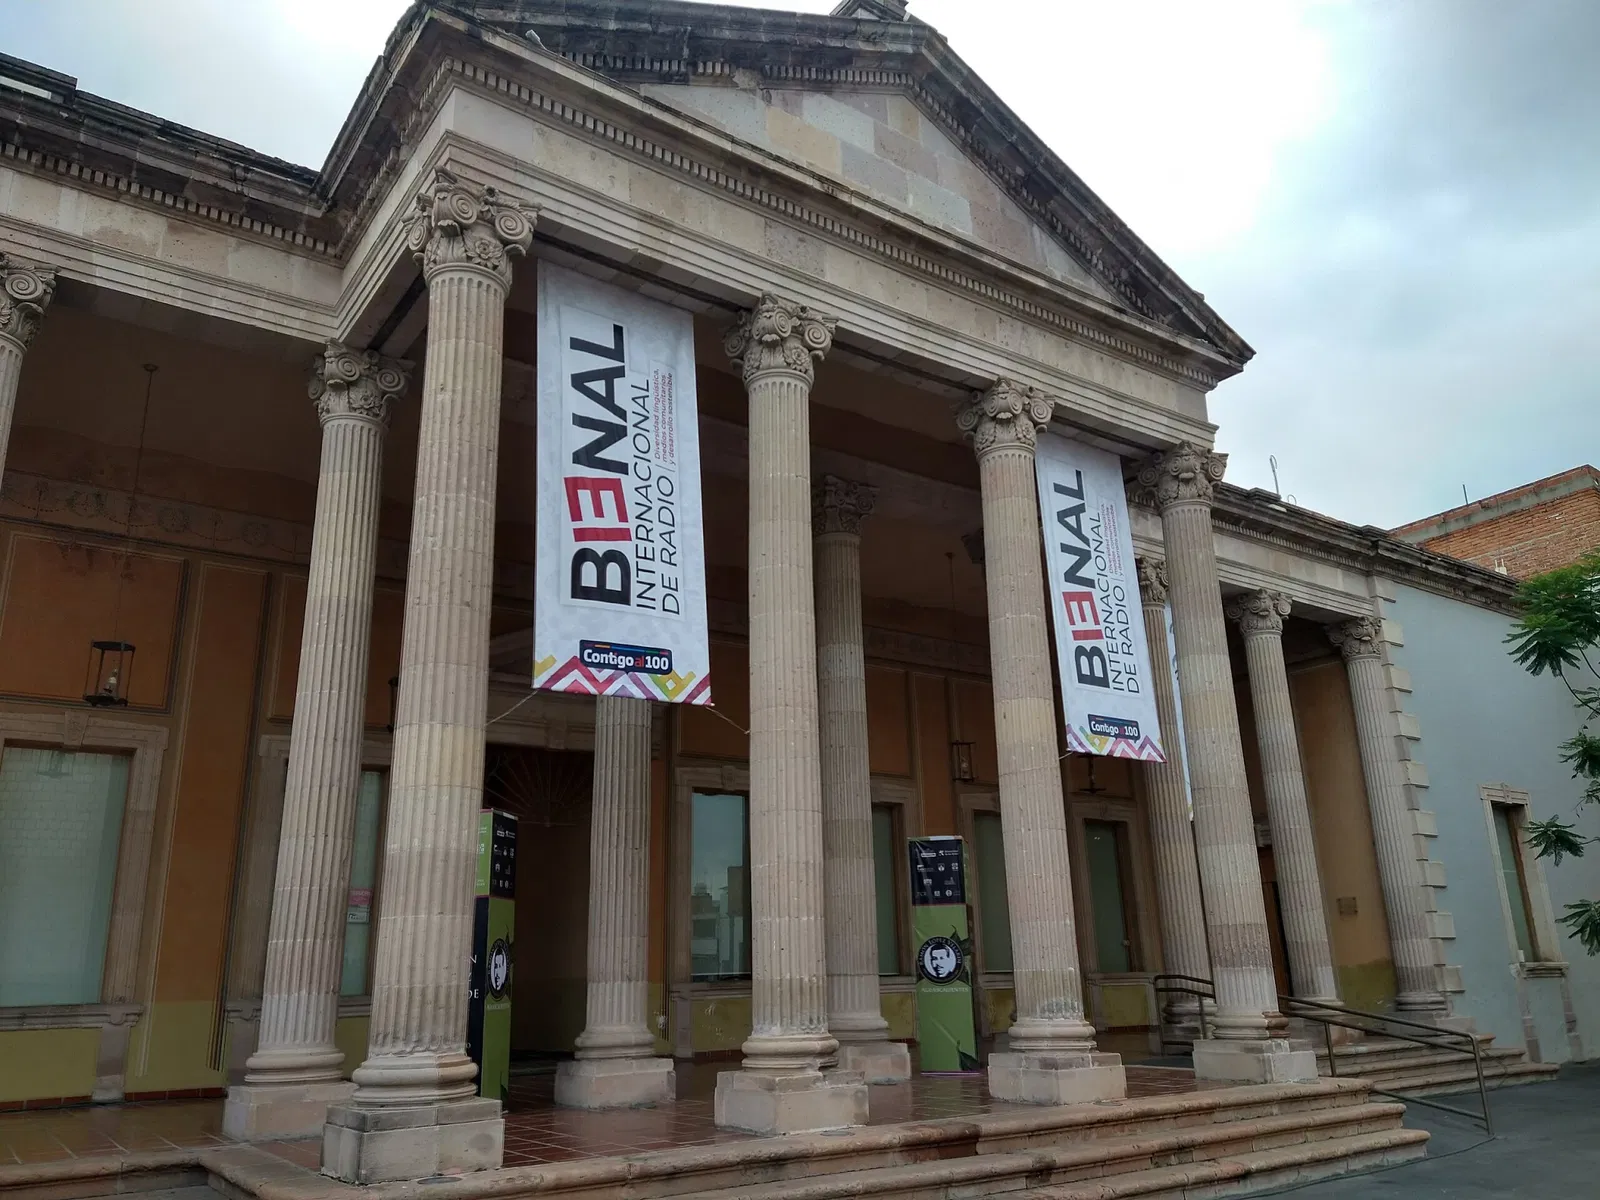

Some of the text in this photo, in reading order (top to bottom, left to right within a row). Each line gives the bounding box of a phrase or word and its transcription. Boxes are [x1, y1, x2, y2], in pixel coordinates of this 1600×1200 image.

[631, 379, 656, 610] INTERNACIONAL
[656, 475, 680, 615] DE RADIO
[583, 649, 669, 671] Contigo al 100
[1089, 512, 1125, 691] INTERNACIONAL
[1112, 585, 1140, 694] DE RADIO
[1090, 720, 1119, 736] Contigo
[1124, 726, 1139, 737] 100
